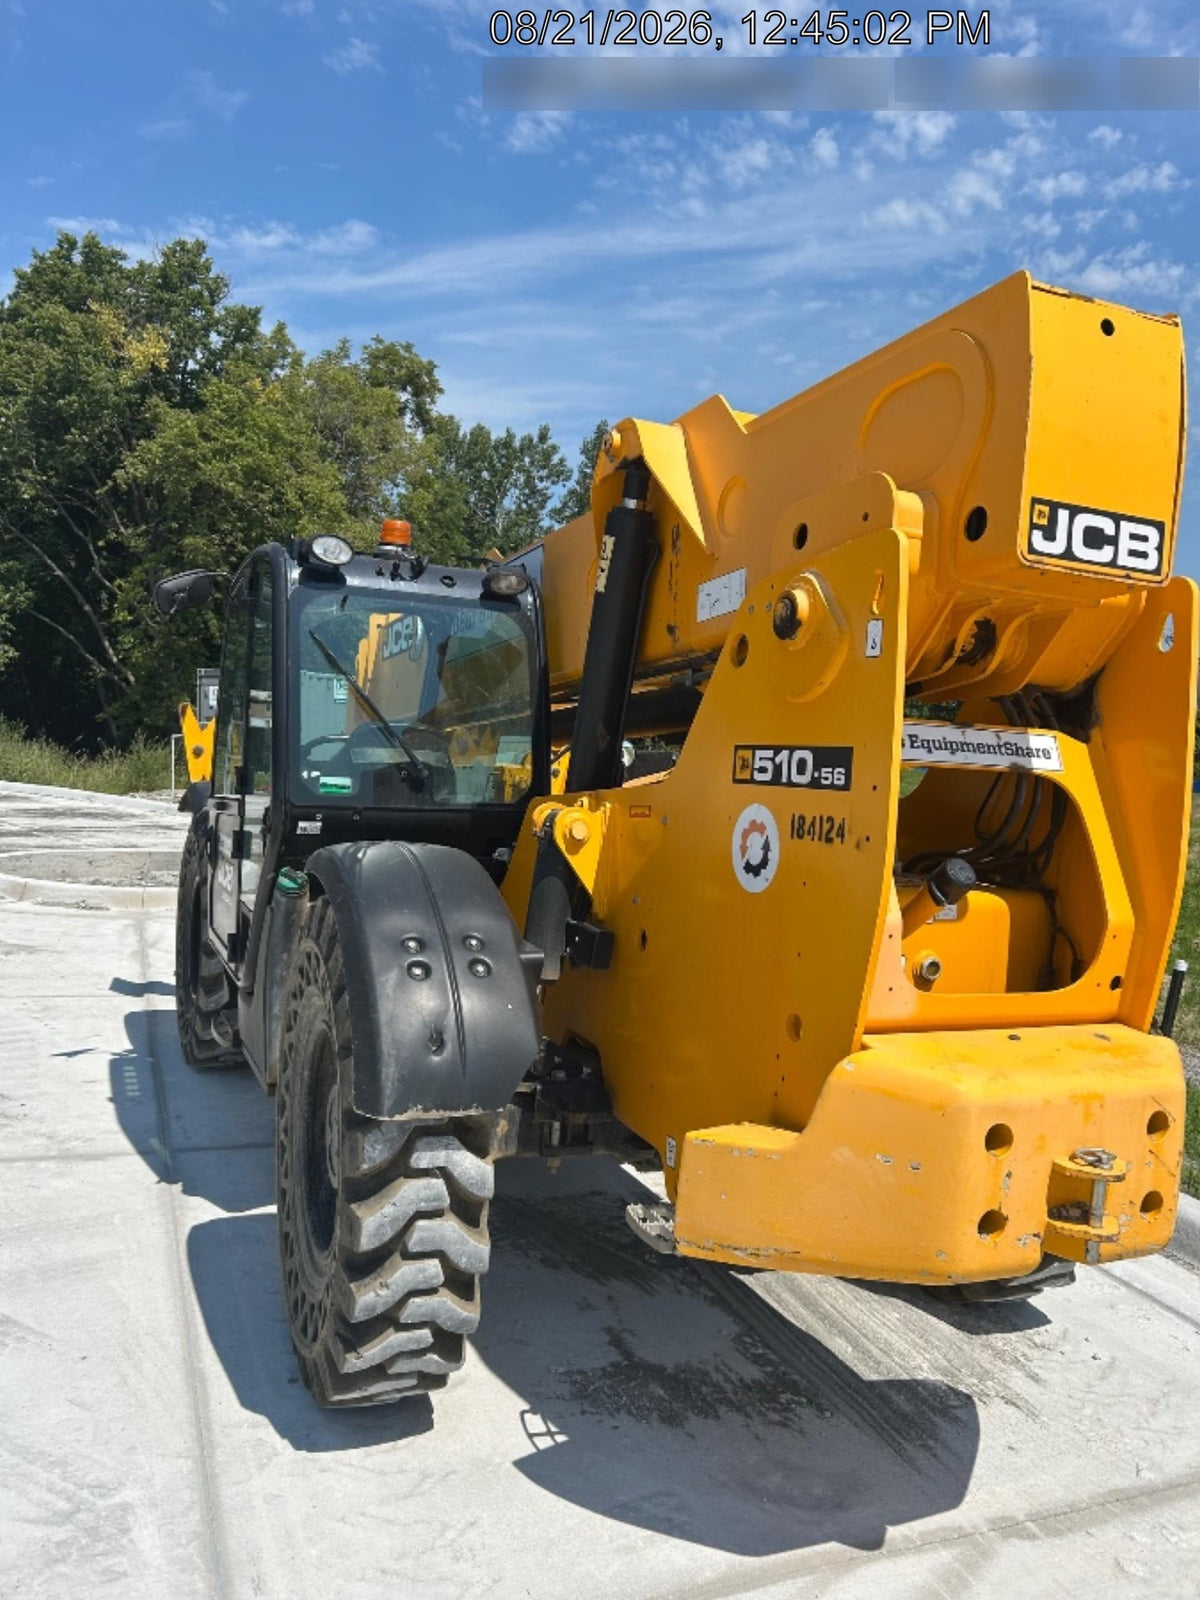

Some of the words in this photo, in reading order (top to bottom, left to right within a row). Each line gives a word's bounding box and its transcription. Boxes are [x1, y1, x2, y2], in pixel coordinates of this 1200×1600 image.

[1031, 508, 1160, 570] JCB
[907, 733, 1052, 760] EquipmentShare
[790, 813, 846, 845] 184124
